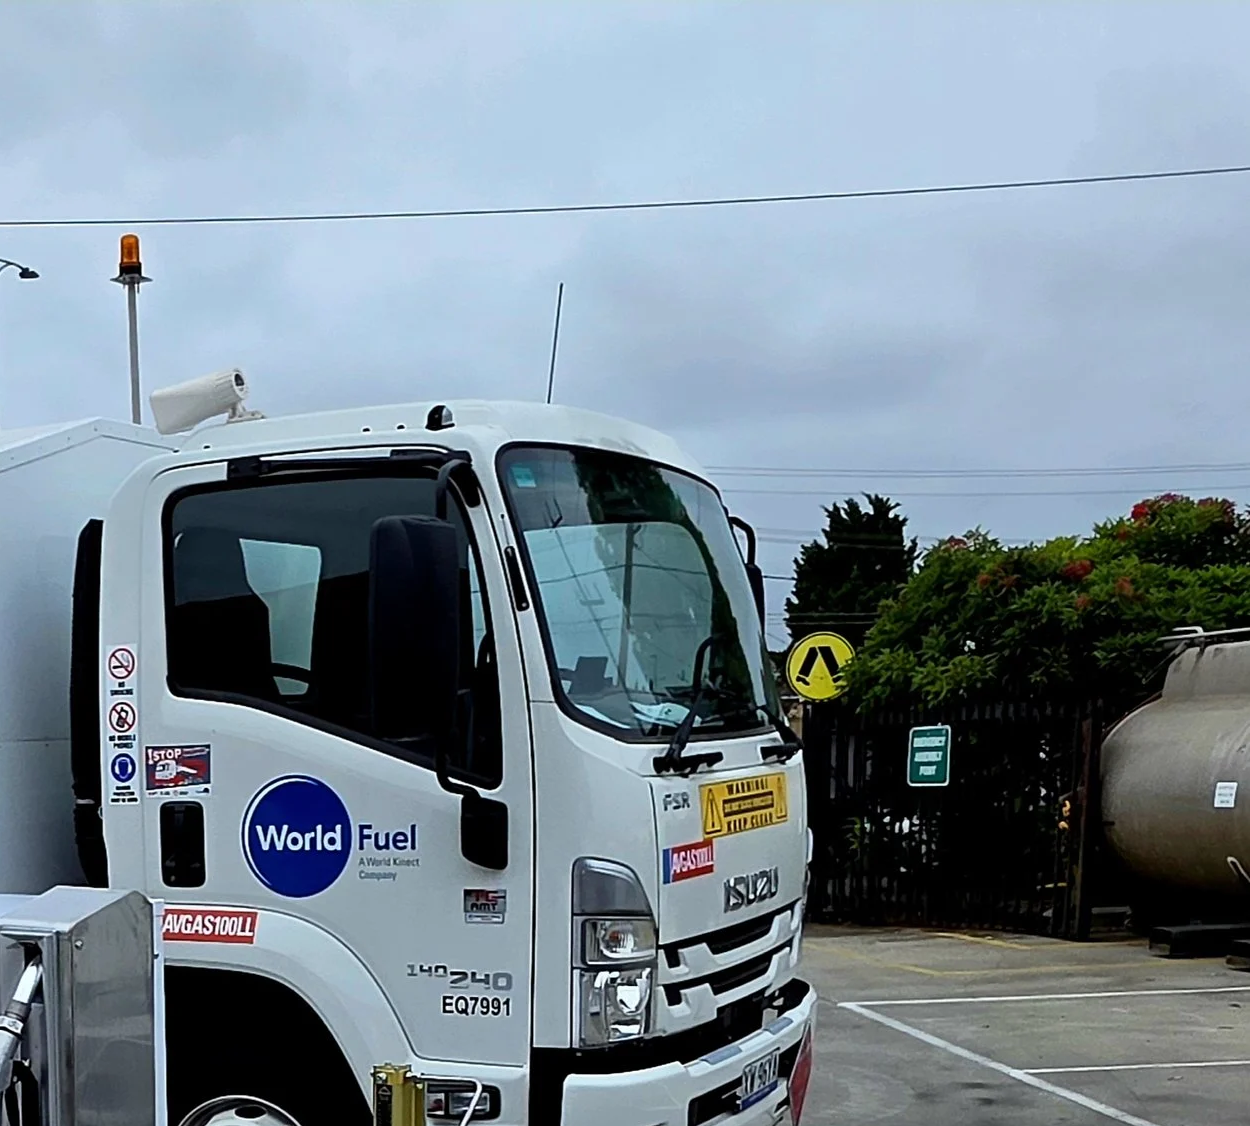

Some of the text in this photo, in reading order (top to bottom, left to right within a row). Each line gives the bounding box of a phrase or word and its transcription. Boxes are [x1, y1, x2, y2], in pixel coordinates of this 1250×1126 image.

[663, 792, 690, 811] FSR
[255, 824, 417, 851] World Fuel
[359, 857, 420, 867] A World Kinect
[359, 870, 397, 881] Company
[723, 866, 779, 914] ISUZU
[162, 913, 254, 936] AVGAS100LL
[442, 995, 511, 1016] EQ7991
